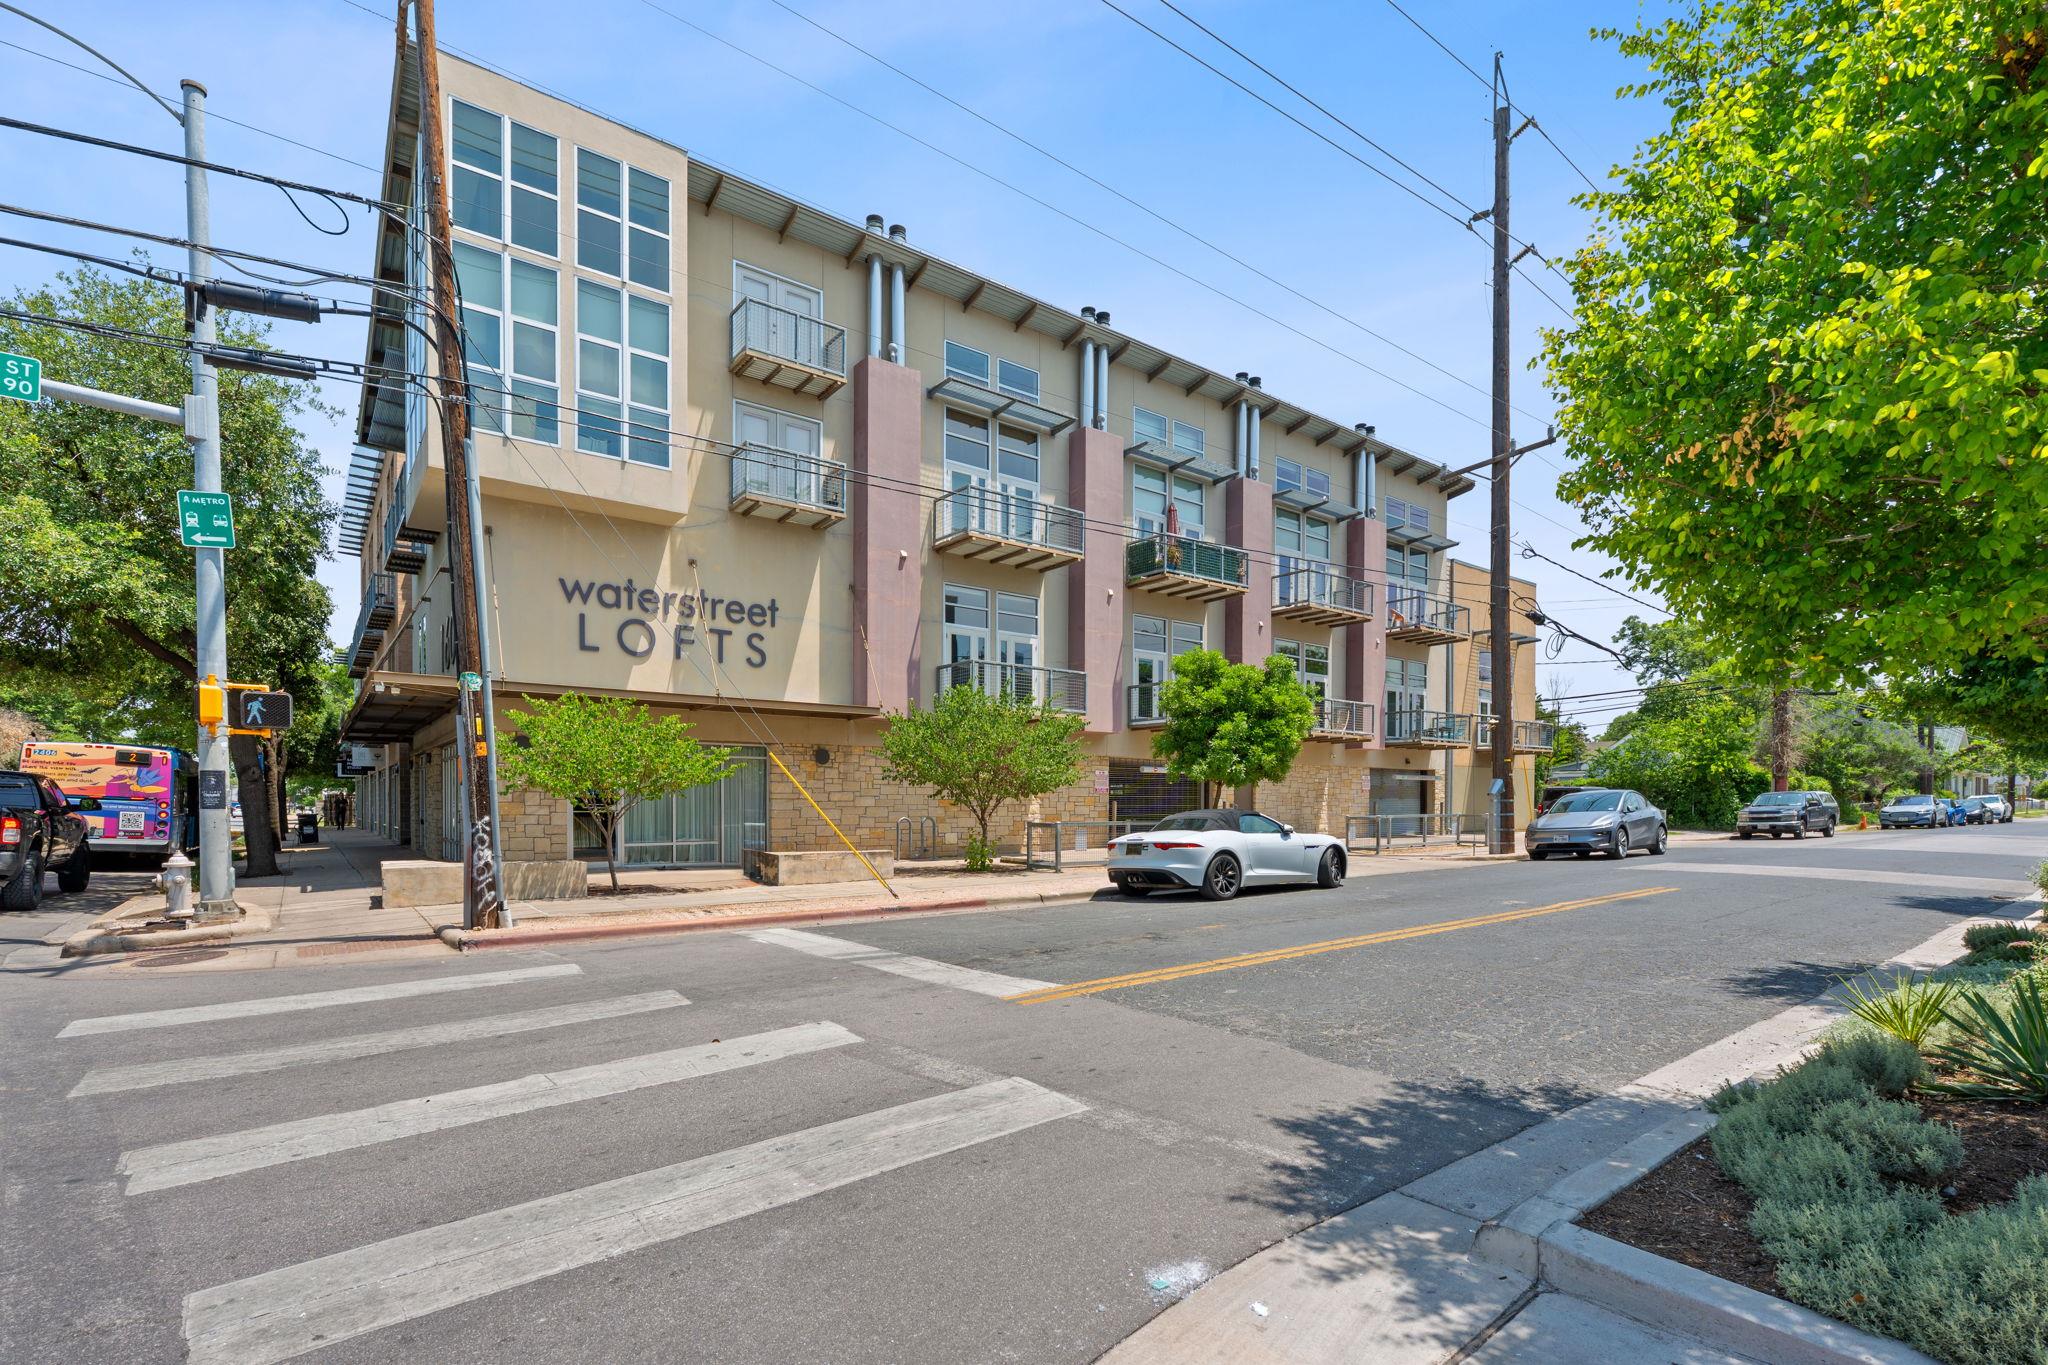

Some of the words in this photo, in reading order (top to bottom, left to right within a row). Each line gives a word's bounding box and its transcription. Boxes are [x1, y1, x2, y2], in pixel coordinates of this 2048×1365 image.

[5, 360, 33, 377] ST
[3, 377, 33, 395] 90
[192, 497, 225, 505] METRO
[558, 577, 779, 628] waterstreet
[578, 612, 767, 668] LOFTS
[129, 754, 137, 762] 2
